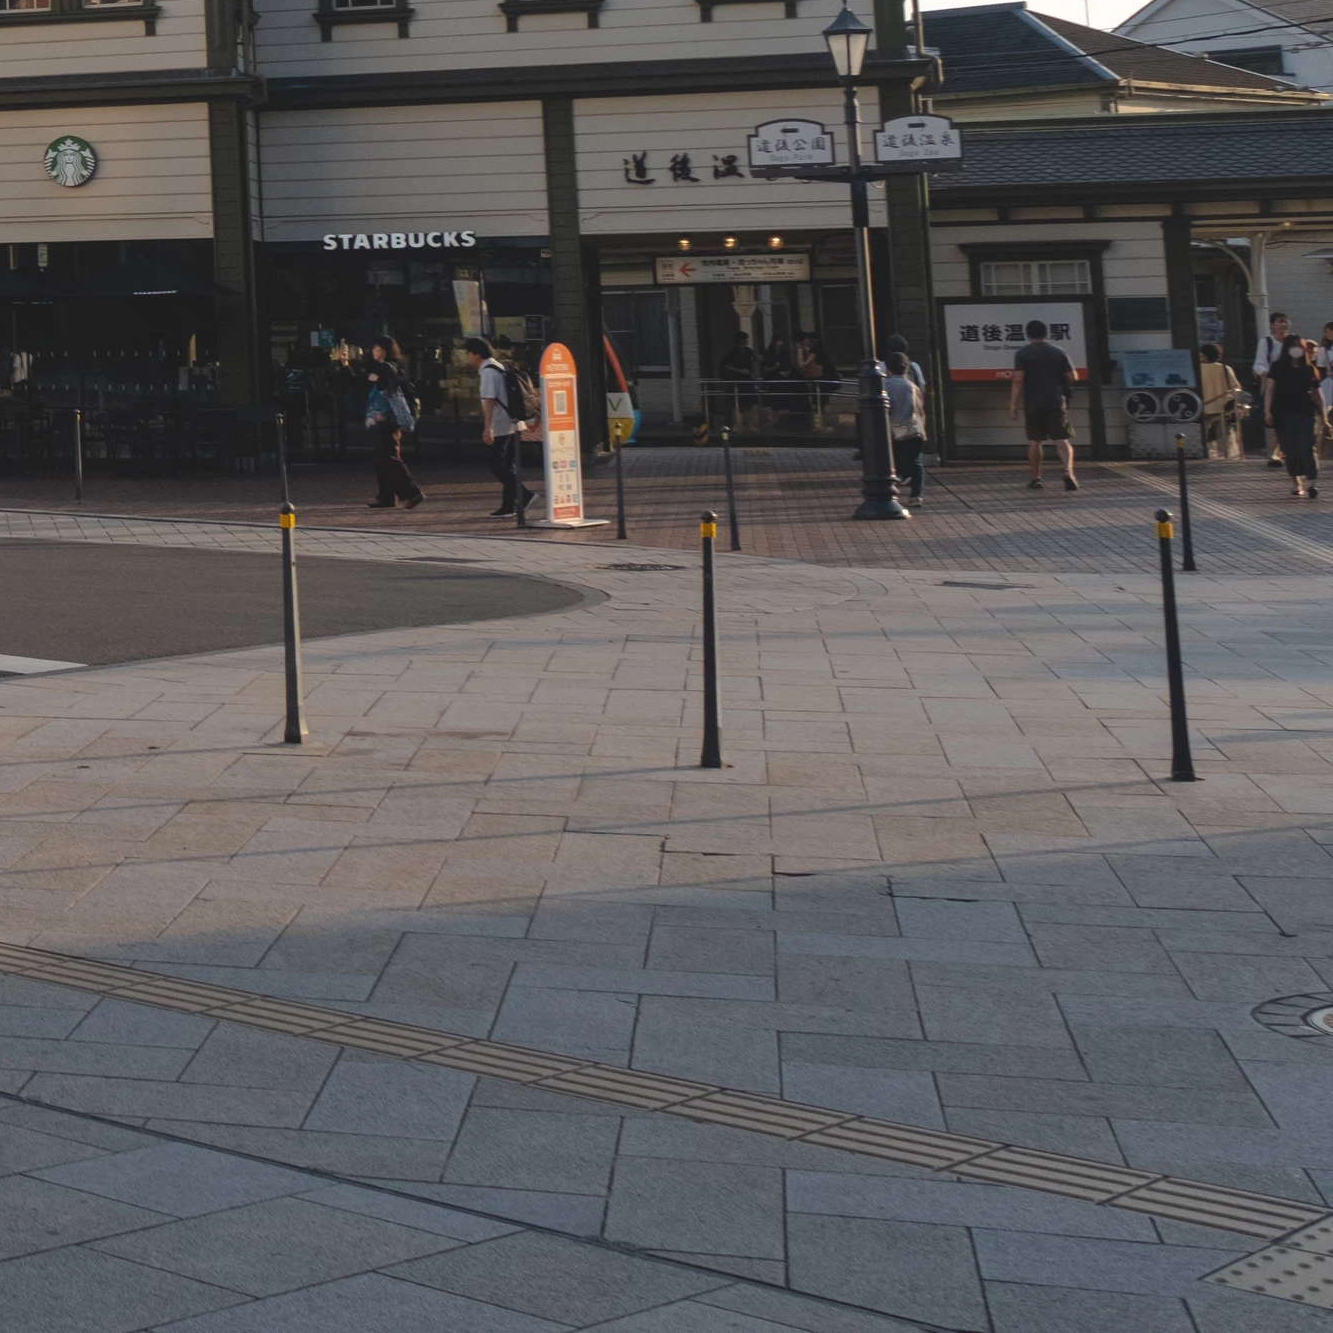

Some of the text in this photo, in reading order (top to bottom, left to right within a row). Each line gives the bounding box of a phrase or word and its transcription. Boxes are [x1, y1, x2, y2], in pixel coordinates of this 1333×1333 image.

[756, 137, 826, 153] 道後公園
[883, 134, 956, 148] 道後温泉
[323, 230, 476, 251] STARBUCKS
[960, 324, 1071, 342] 道後温駅
